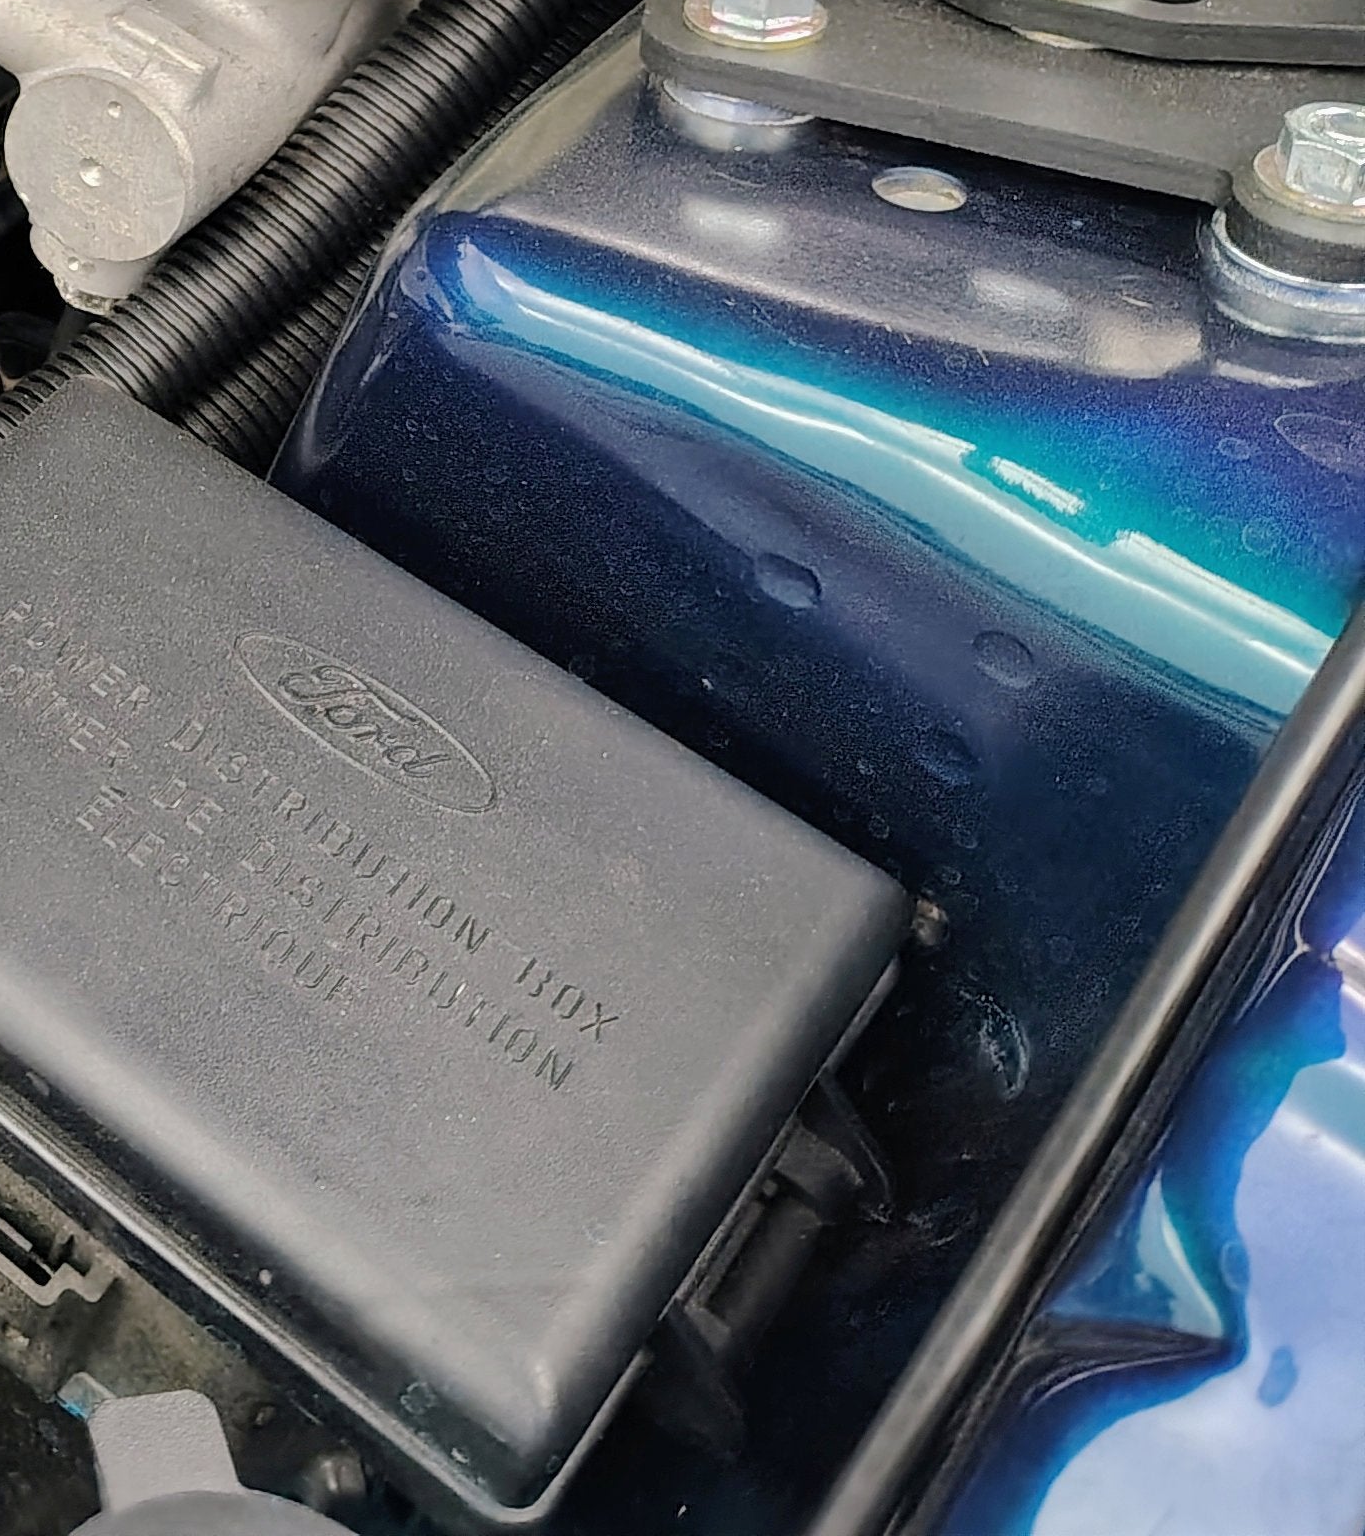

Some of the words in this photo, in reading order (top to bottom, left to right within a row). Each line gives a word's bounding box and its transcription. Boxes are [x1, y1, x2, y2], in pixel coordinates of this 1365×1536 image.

[149, 776, 226, 835] DE
[239, 837, 573, 1092] DISTRIBUTION
[163, 715, 493, 955] DISTRIBUTION
[515, 957, 620, 1043] BOX
